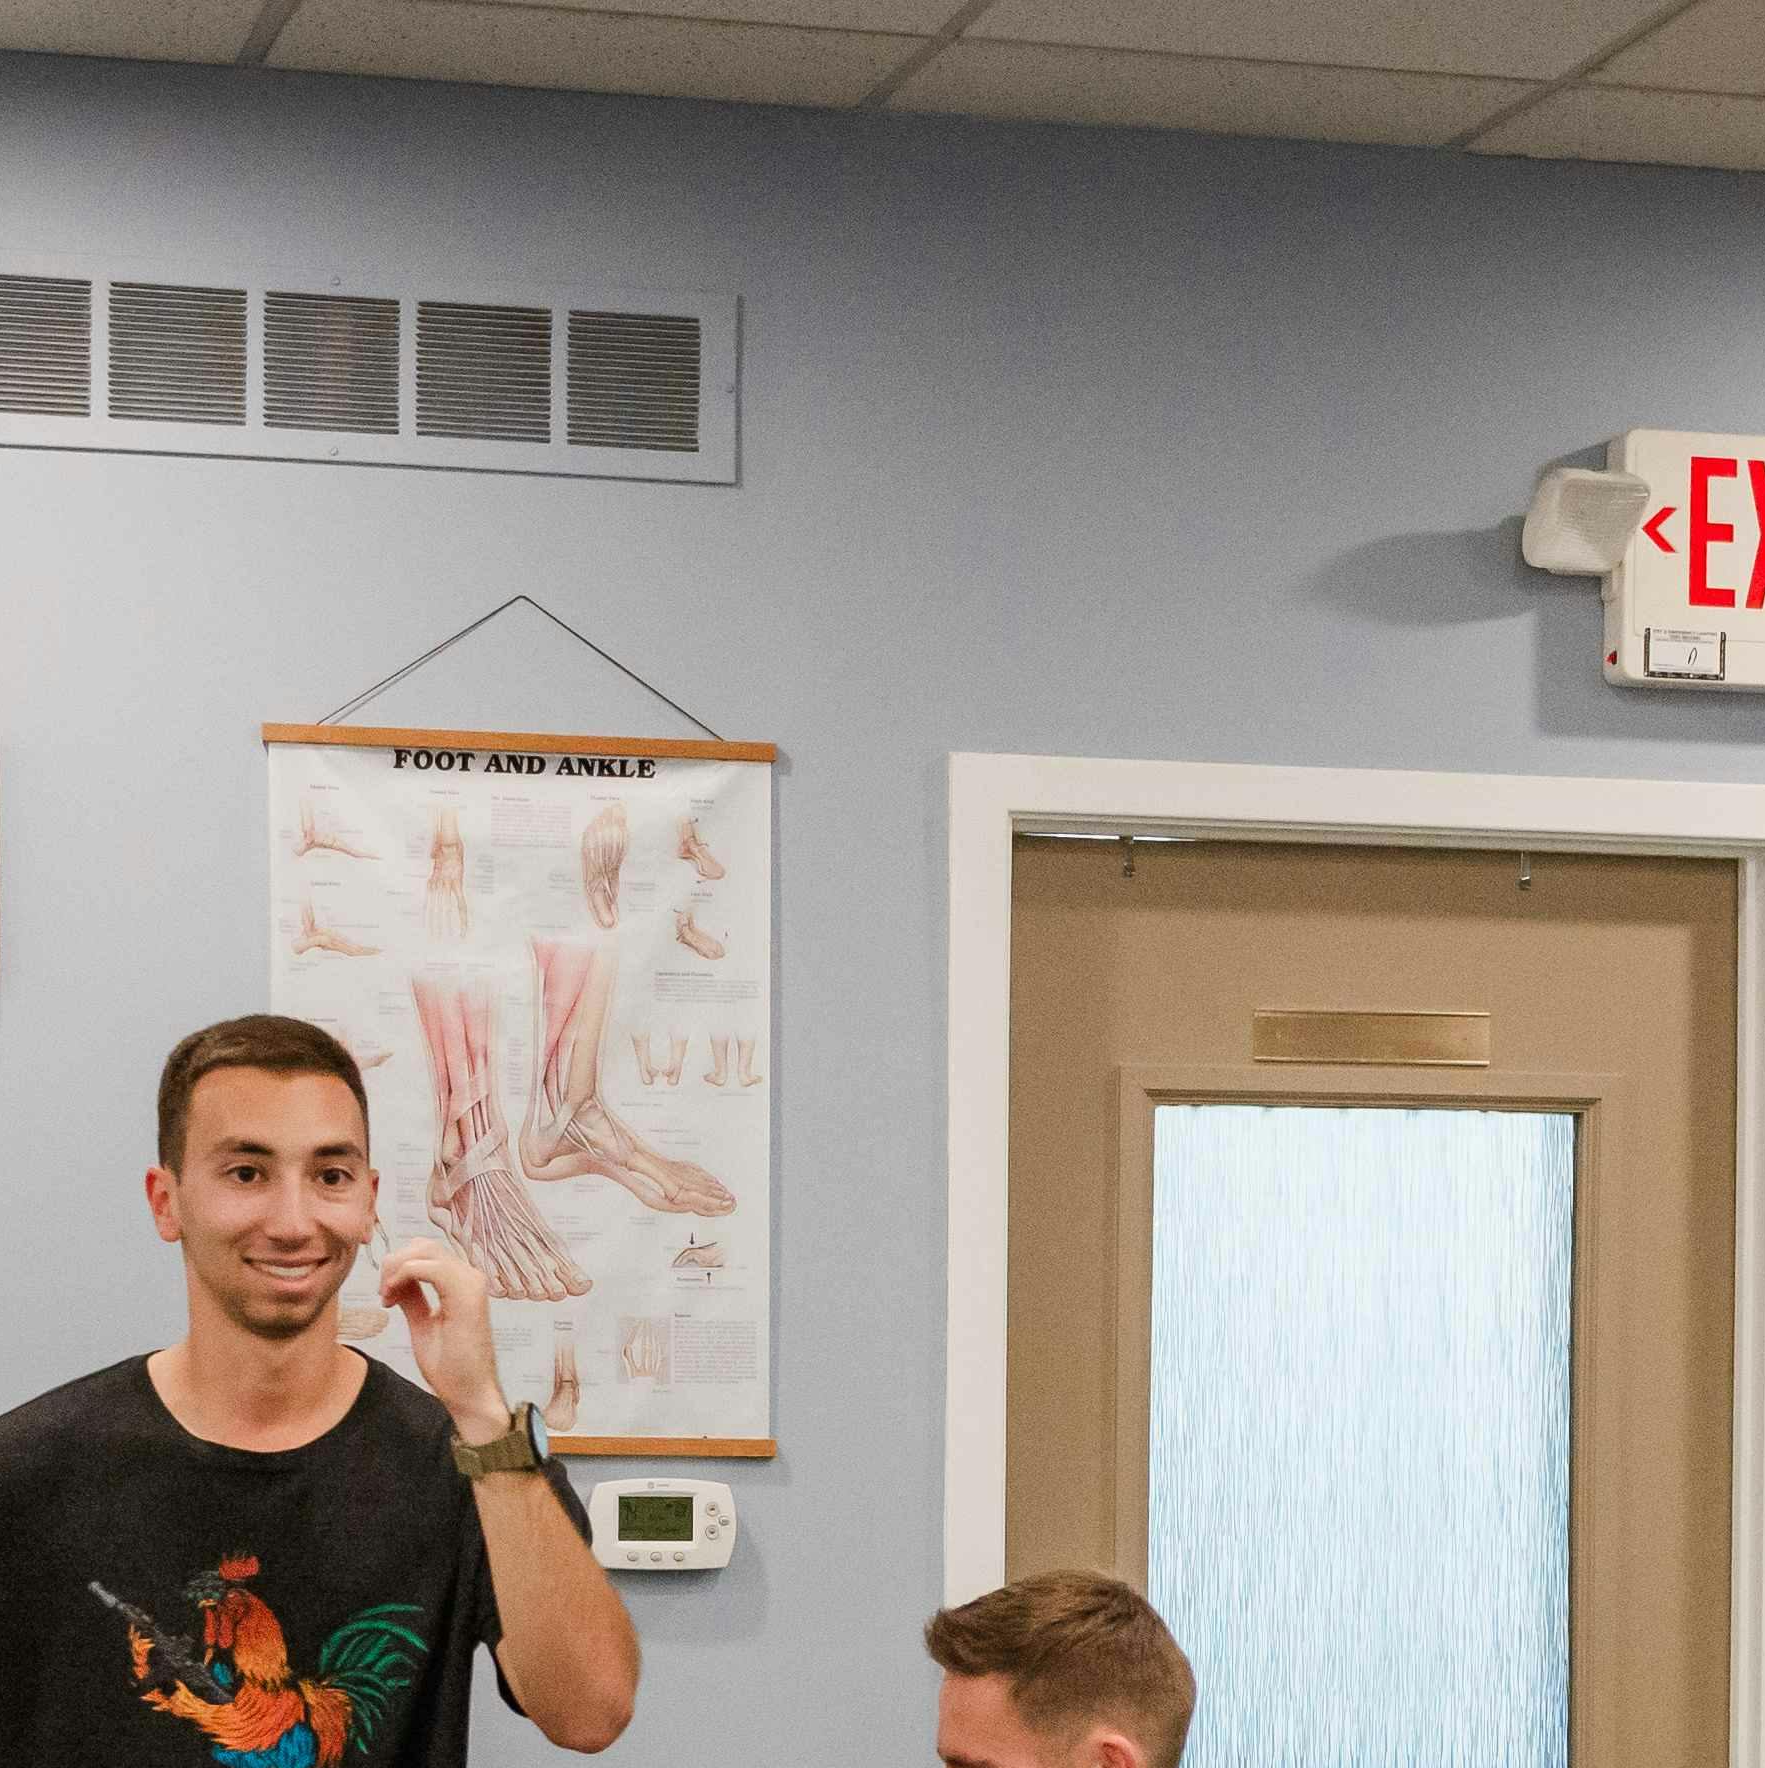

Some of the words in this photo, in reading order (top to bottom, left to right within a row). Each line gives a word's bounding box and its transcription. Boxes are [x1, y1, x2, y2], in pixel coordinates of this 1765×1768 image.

[393, 749, 475, 771] FOOT
[484, 754, 545, 775] AND
[556, 757, 656, 777] ANKLE
